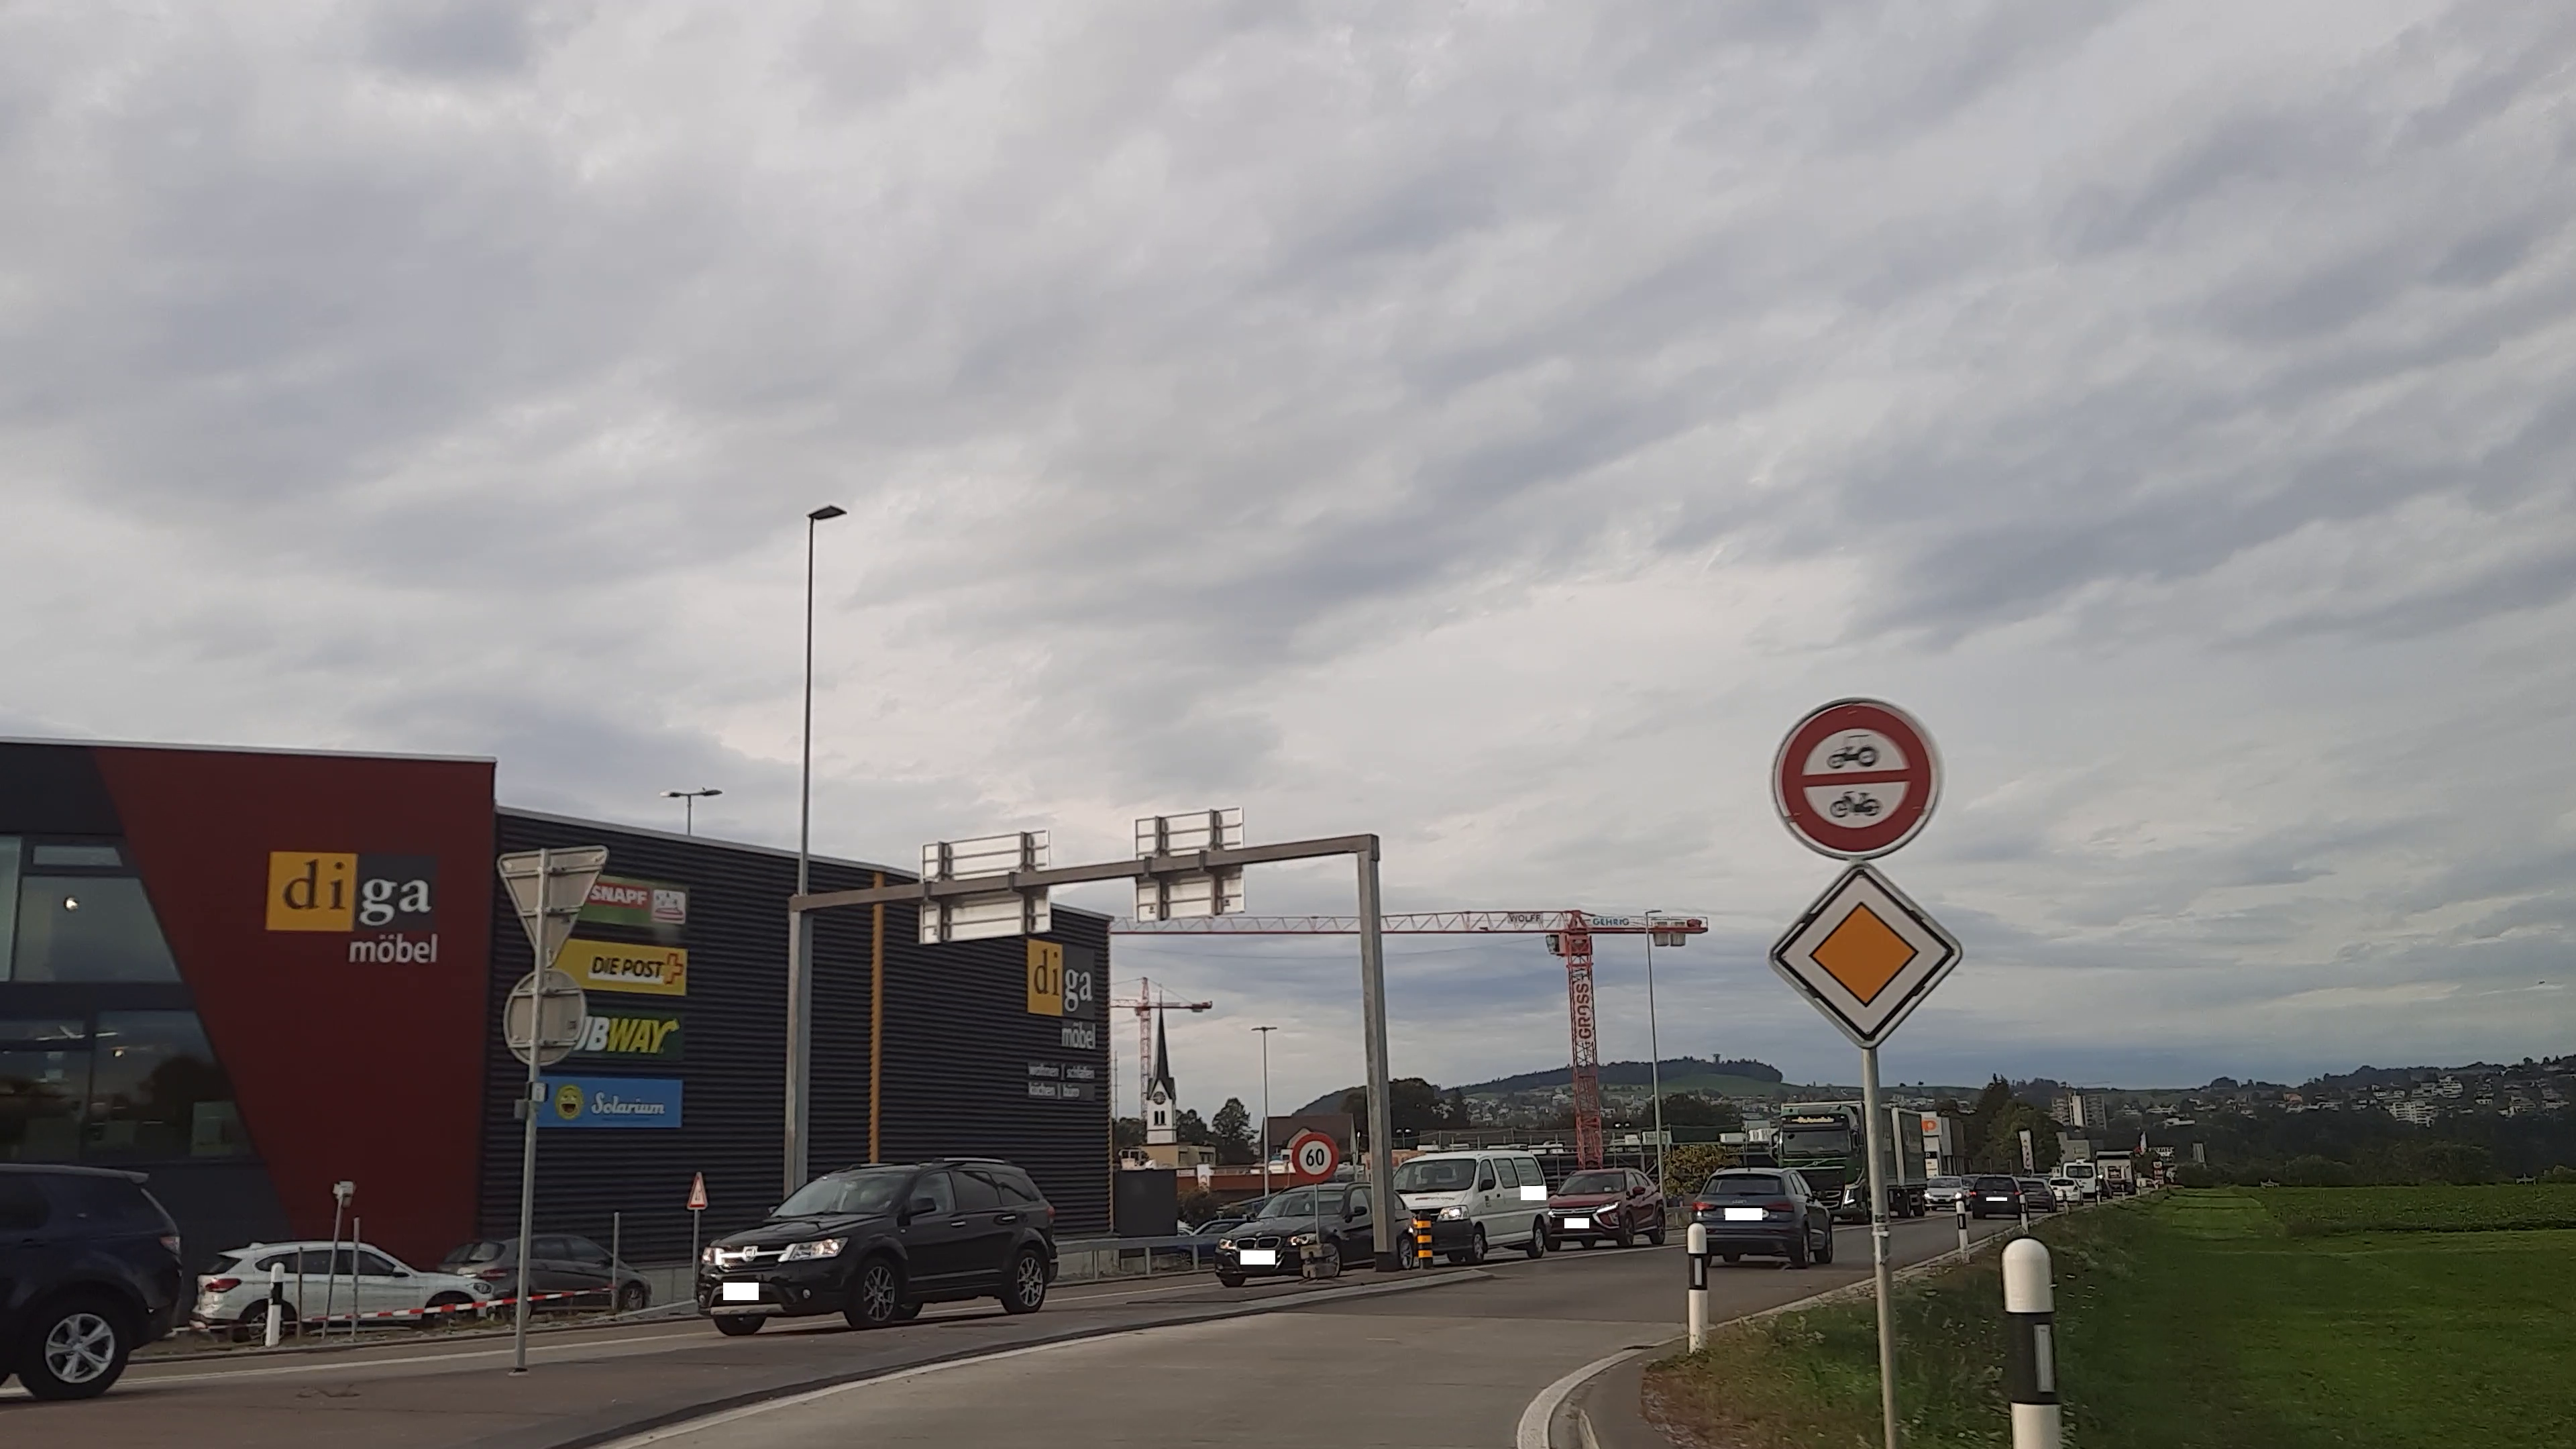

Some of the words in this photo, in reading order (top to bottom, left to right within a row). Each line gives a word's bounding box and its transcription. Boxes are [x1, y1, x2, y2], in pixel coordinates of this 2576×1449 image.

[282, 859, 432, 926] diga
[589, 883, 649, 906] SNAPF
[348, 933, 438, 963] möbel
[591, 956, 619, 975] DIE
[621, 959, 665, 979] POST
[1034, 948, 1093, 1012] diga
[1576, 982, 1592, 1040] GROSS
[572, 1016, 680, 1054] UBWAY
[1061, 1020, 1096, 1050] möbel
[590, 1091, 665, 1115] Solarium
[1305, 1148, 1325, 1167] 60
